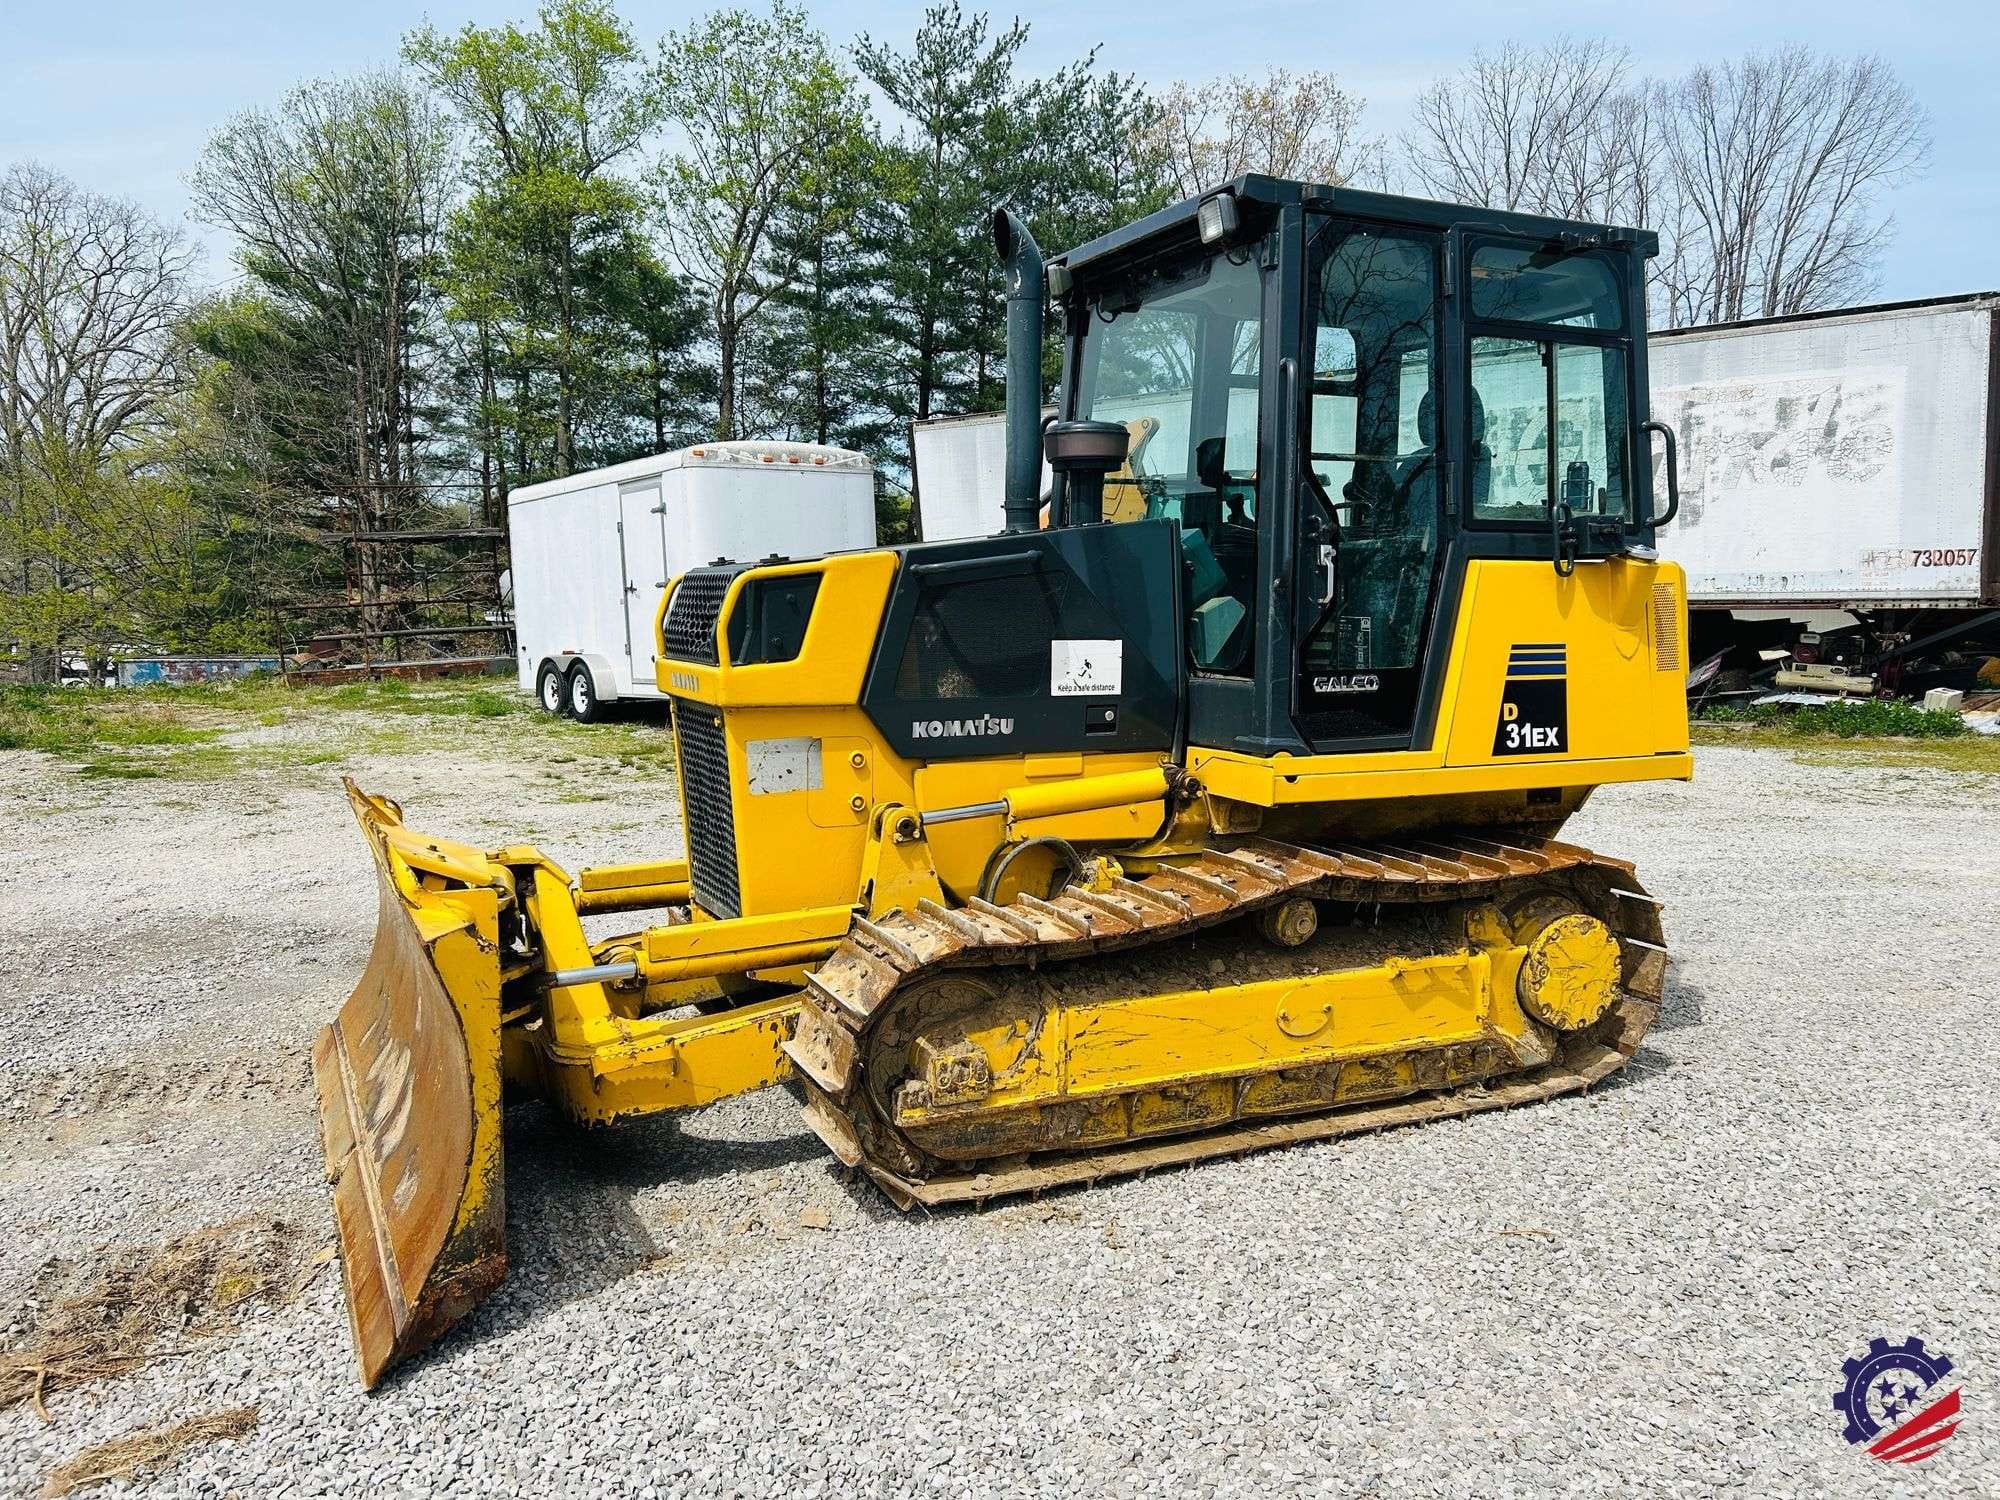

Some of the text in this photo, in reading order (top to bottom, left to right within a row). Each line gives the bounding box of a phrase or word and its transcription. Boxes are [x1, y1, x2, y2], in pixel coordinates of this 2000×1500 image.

[1912, 548, 1978, 568] 732057
[1057, 684, 1073, 693] Keep
[1078, 684, 1091, 692] safe
[1091, 683, 1116, 692] distance
[1312, 675, 1379, 693] GALEO
[1503, 703, 1518, 721] D
[912, 713, 1015, 738] KOMATSU
[1505, 722, 1560, 748] 31EX
